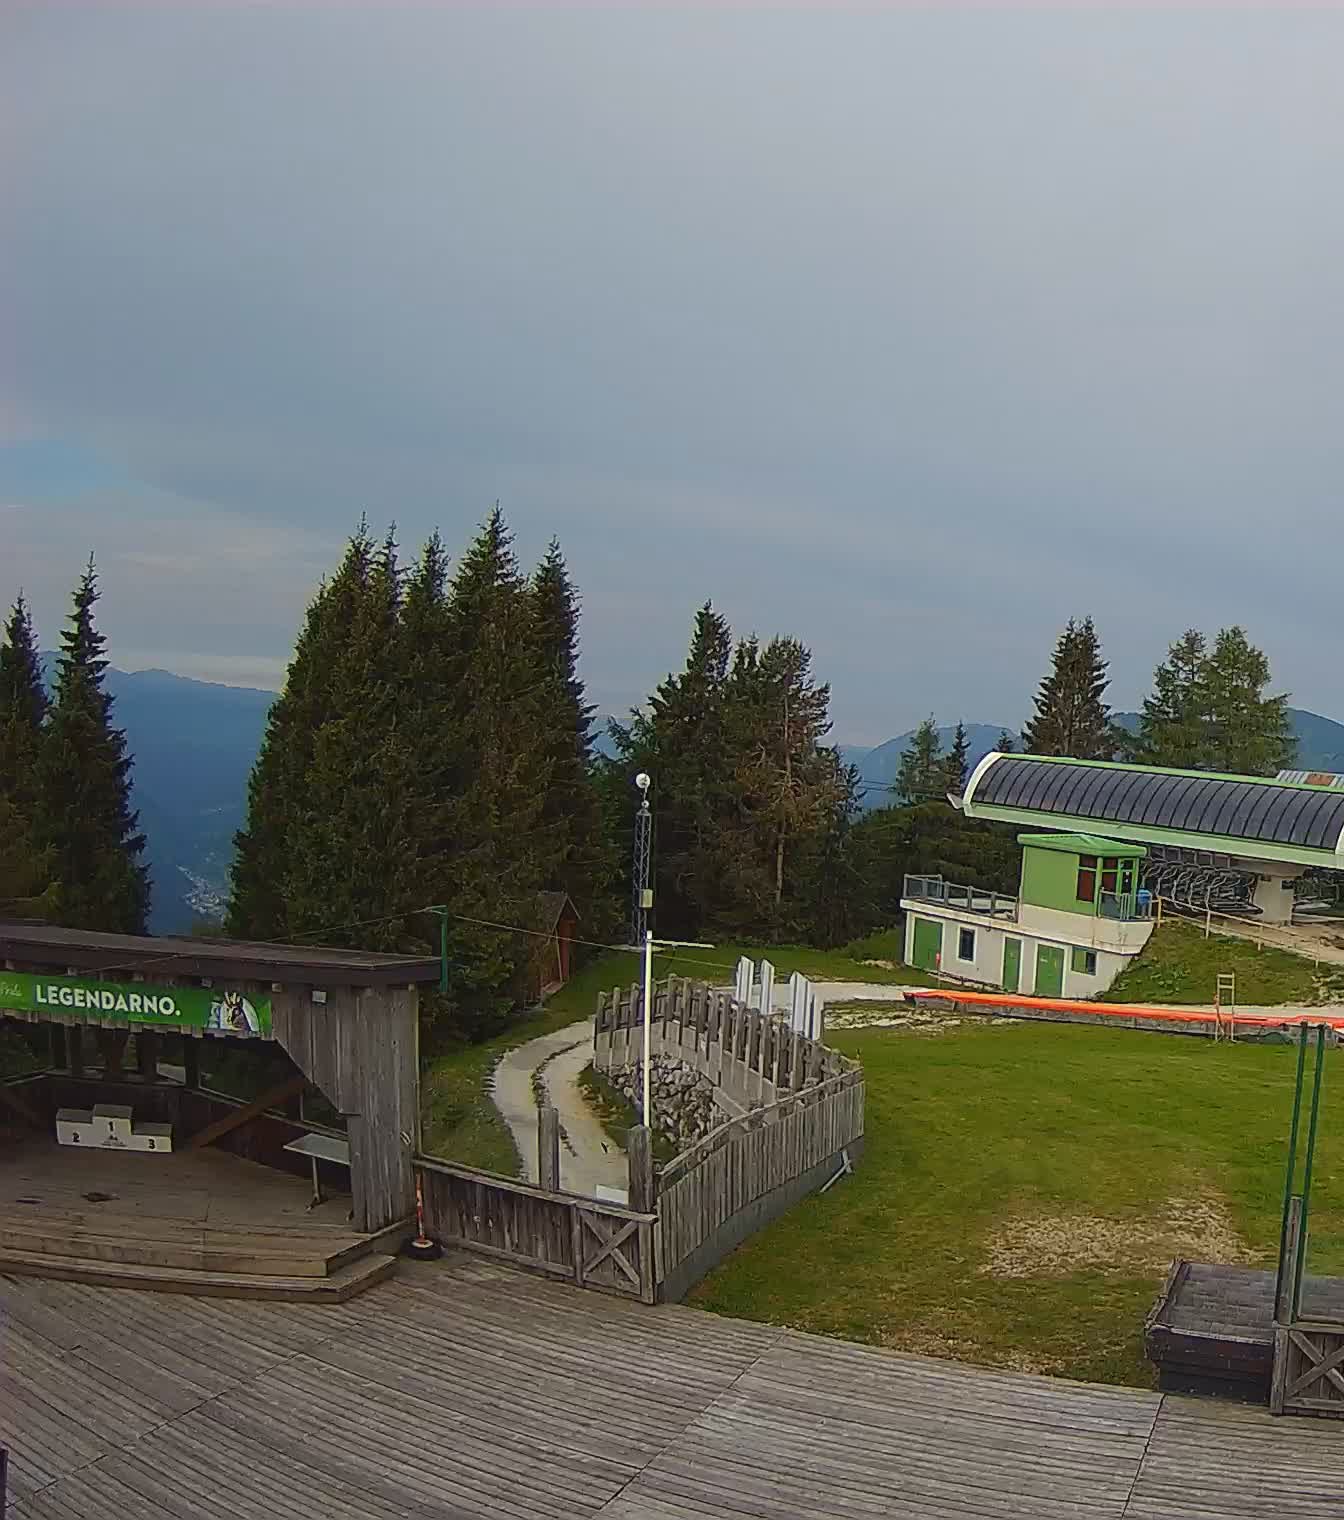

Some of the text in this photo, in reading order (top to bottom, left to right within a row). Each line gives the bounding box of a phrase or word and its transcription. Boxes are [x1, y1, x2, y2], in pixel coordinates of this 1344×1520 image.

[36, 984, 181, 1016] LEGENDARNO.
[72, 1132, 80, 1143] 2
[148, 1138, 156, 1150] 3
